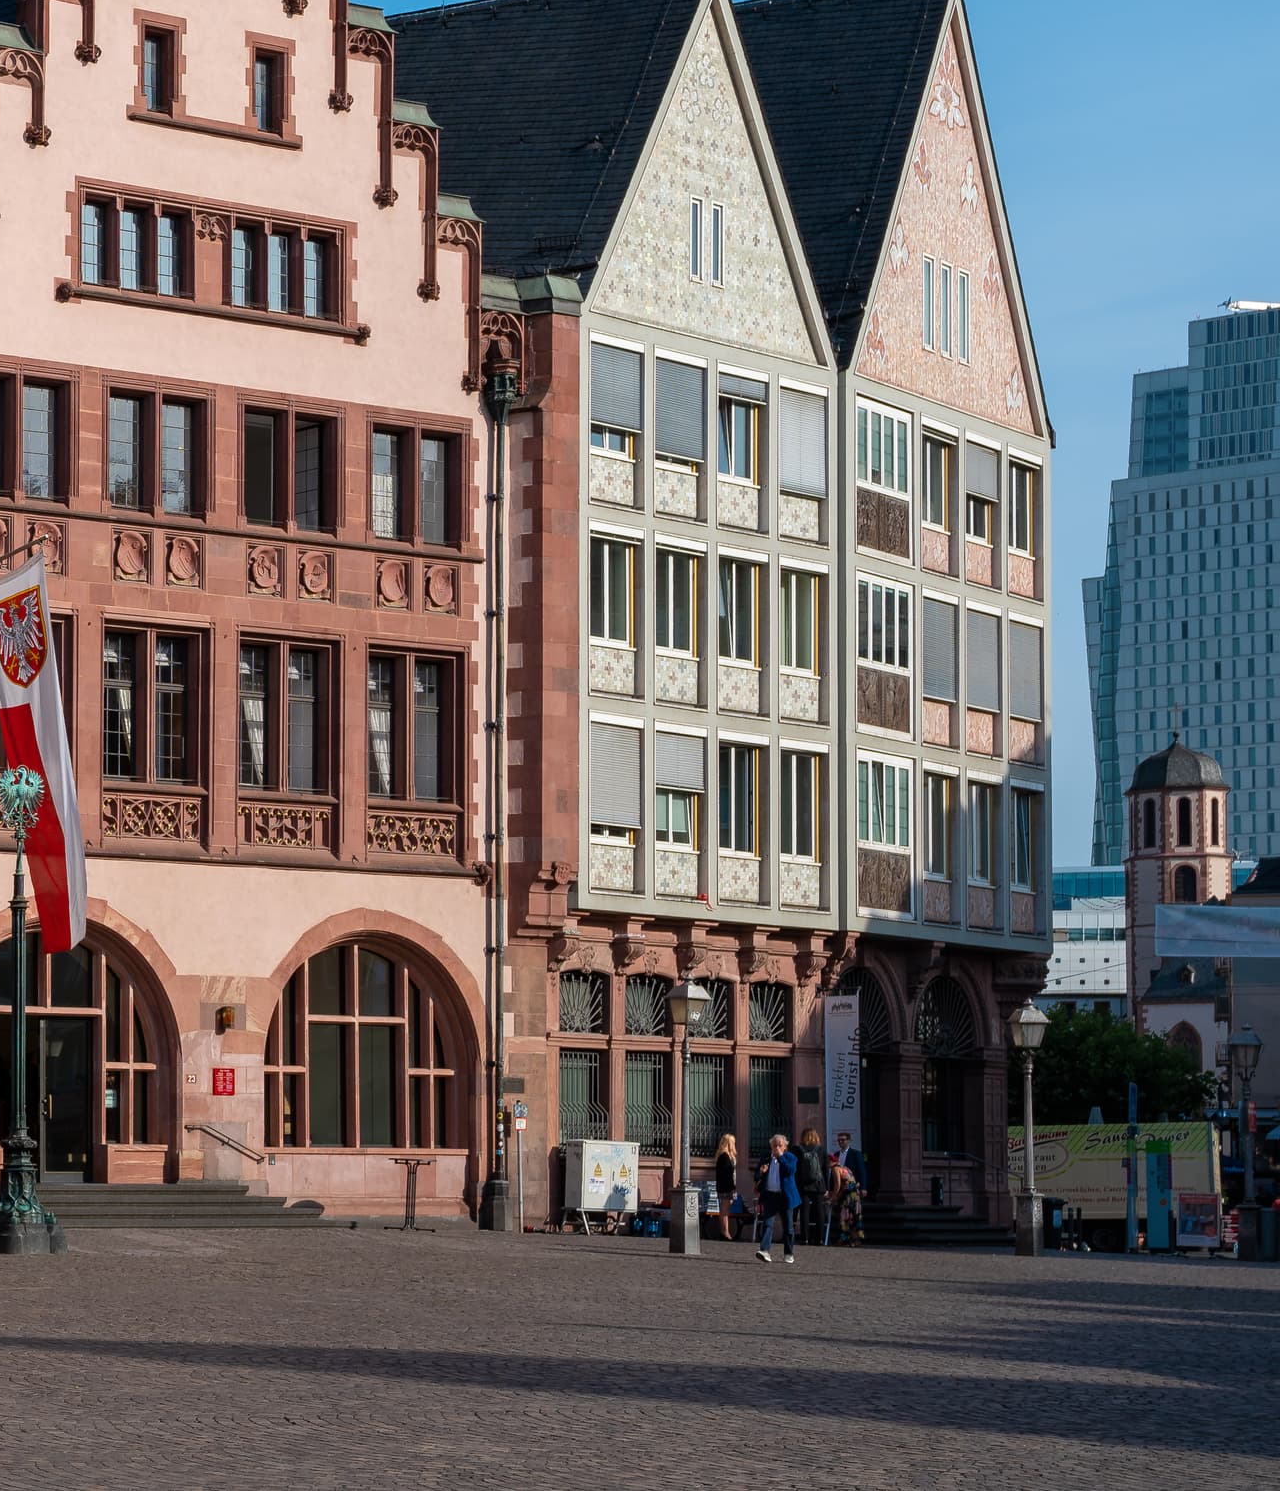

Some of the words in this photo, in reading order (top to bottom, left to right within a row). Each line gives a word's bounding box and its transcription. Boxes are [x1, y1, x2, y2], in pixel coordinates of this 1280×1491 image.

[848, 1027, 861, 1056] Info
[187, 1074, 196, 1083] 23
[829, 1052, 846, 1109] Frankfurt
[841, 1060, 859, 1111] Tourist
